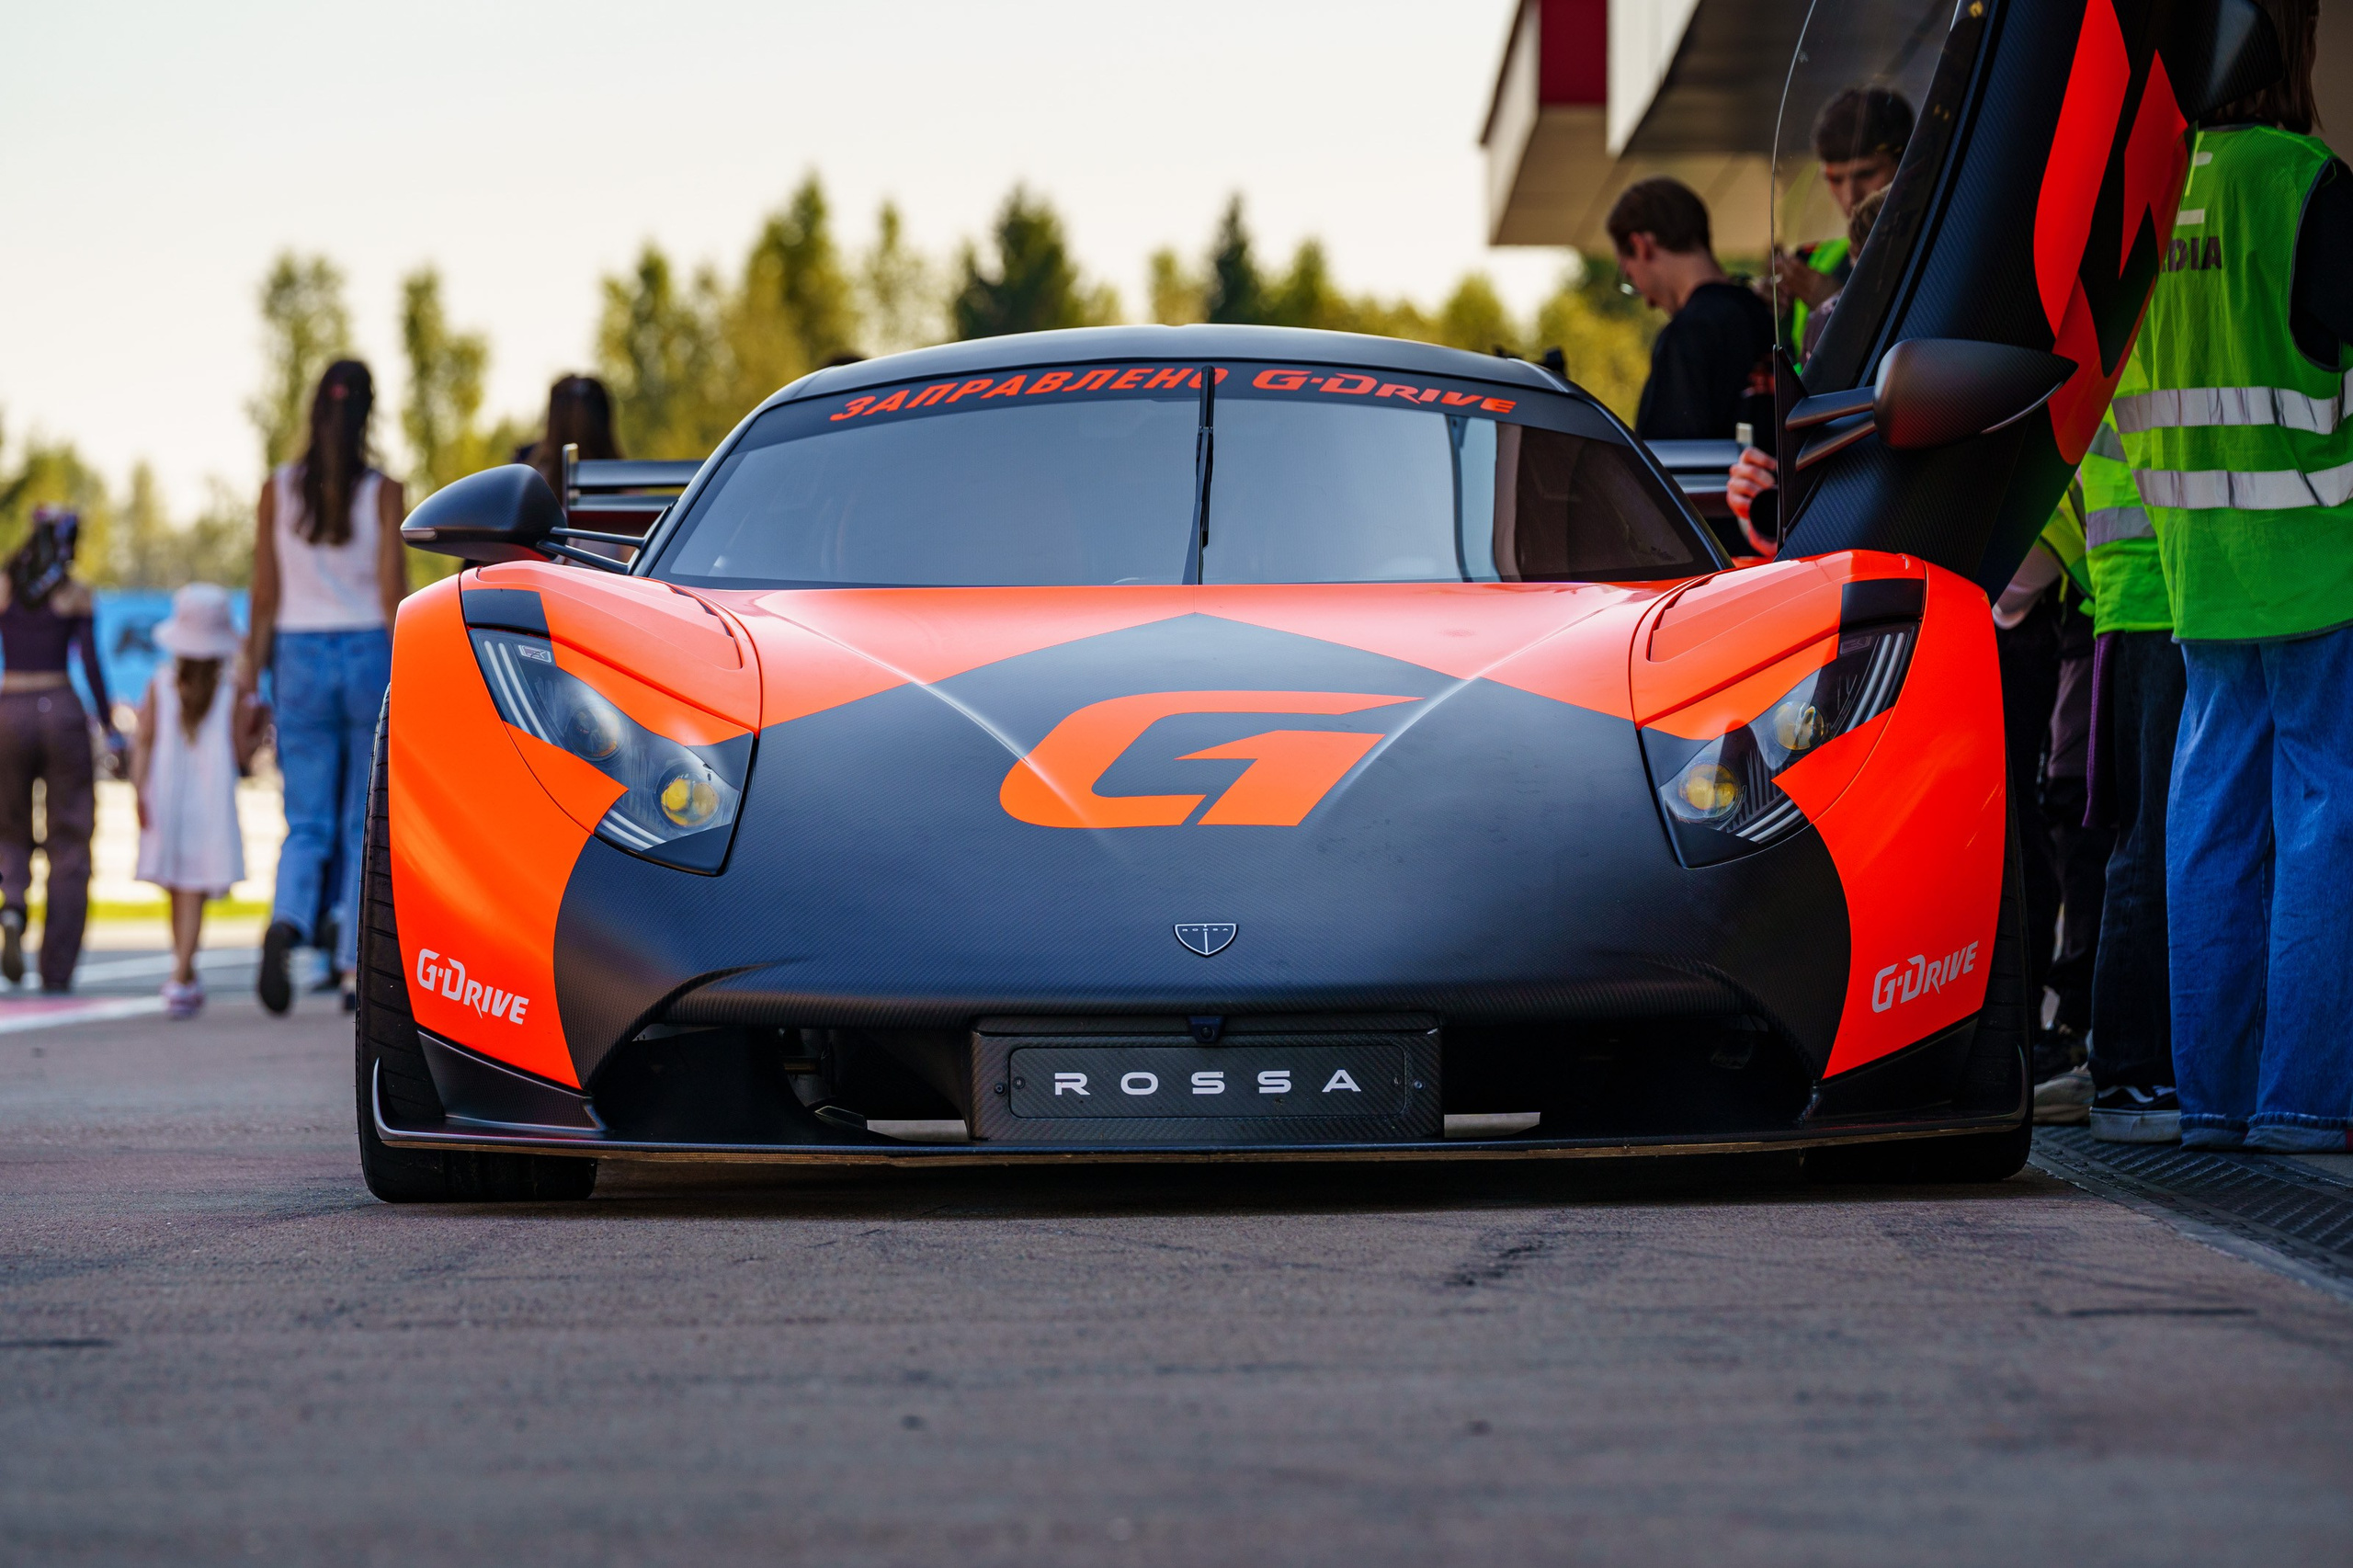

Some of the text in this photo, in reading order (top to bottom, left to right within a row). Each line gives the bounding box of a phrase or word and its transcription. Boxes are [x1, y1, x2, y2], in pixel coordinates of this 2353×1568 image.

[2162, 236, 2222, 272] DIA
[999, 690, 1427, 829] G
[1054, 1069, 1361, 1096] ROSSA
